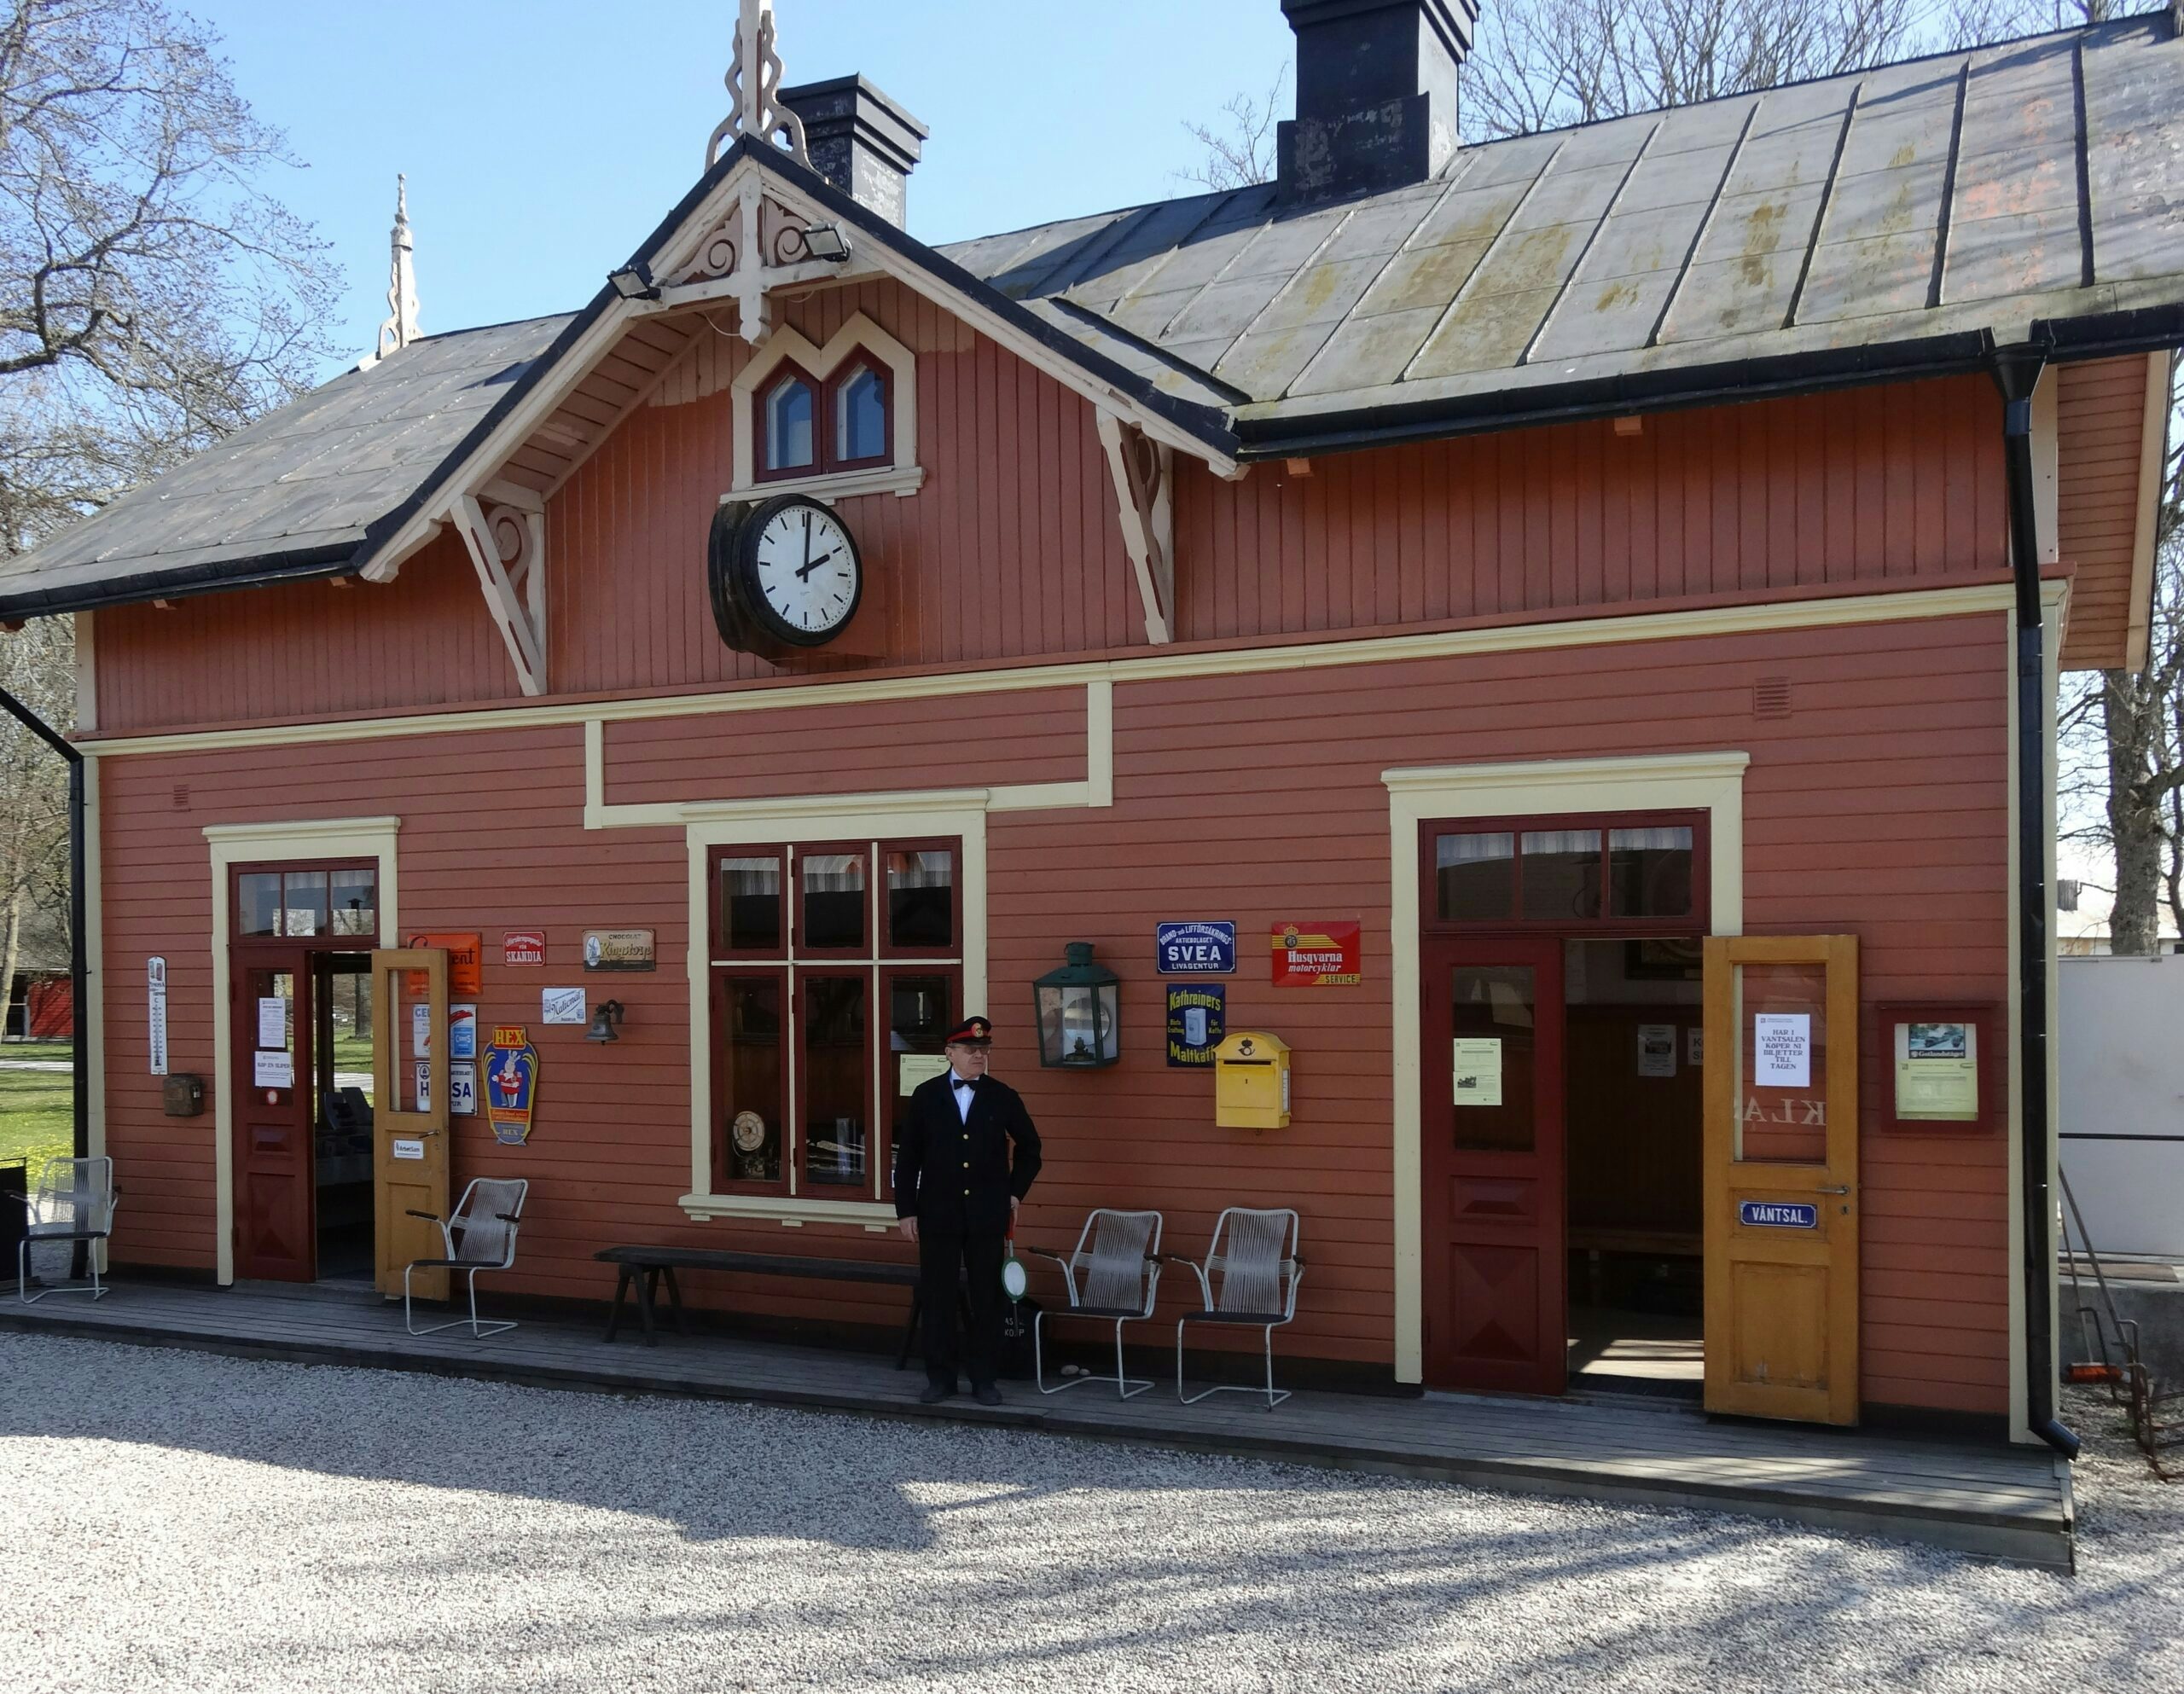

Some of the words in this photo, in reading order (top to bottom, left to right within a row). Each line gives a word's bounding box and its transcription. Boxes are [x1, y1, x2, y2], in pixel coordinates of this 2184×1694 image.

[506, 951, 543, 962] SKANDIA
[1168, 945, 1222, 961] SVEA
[1287, 951, 1343, 964] Husqvarna
[1288, 963, 1341, 974] motorcyklar
[1325, 974, 1356, 983] SERVICE
[1170, 989, 1221, 1012] Kathreiners
[494, 1030, 525, 1045] REX
[1170, 1040, 1216, 1063] Maltkaff
[1763, 1049, 1804, 1058] BILJETTER
[421, 1082, 472, 1098] HSA
[1751, 1204, 1809, 1224] VÄNTSAL.
